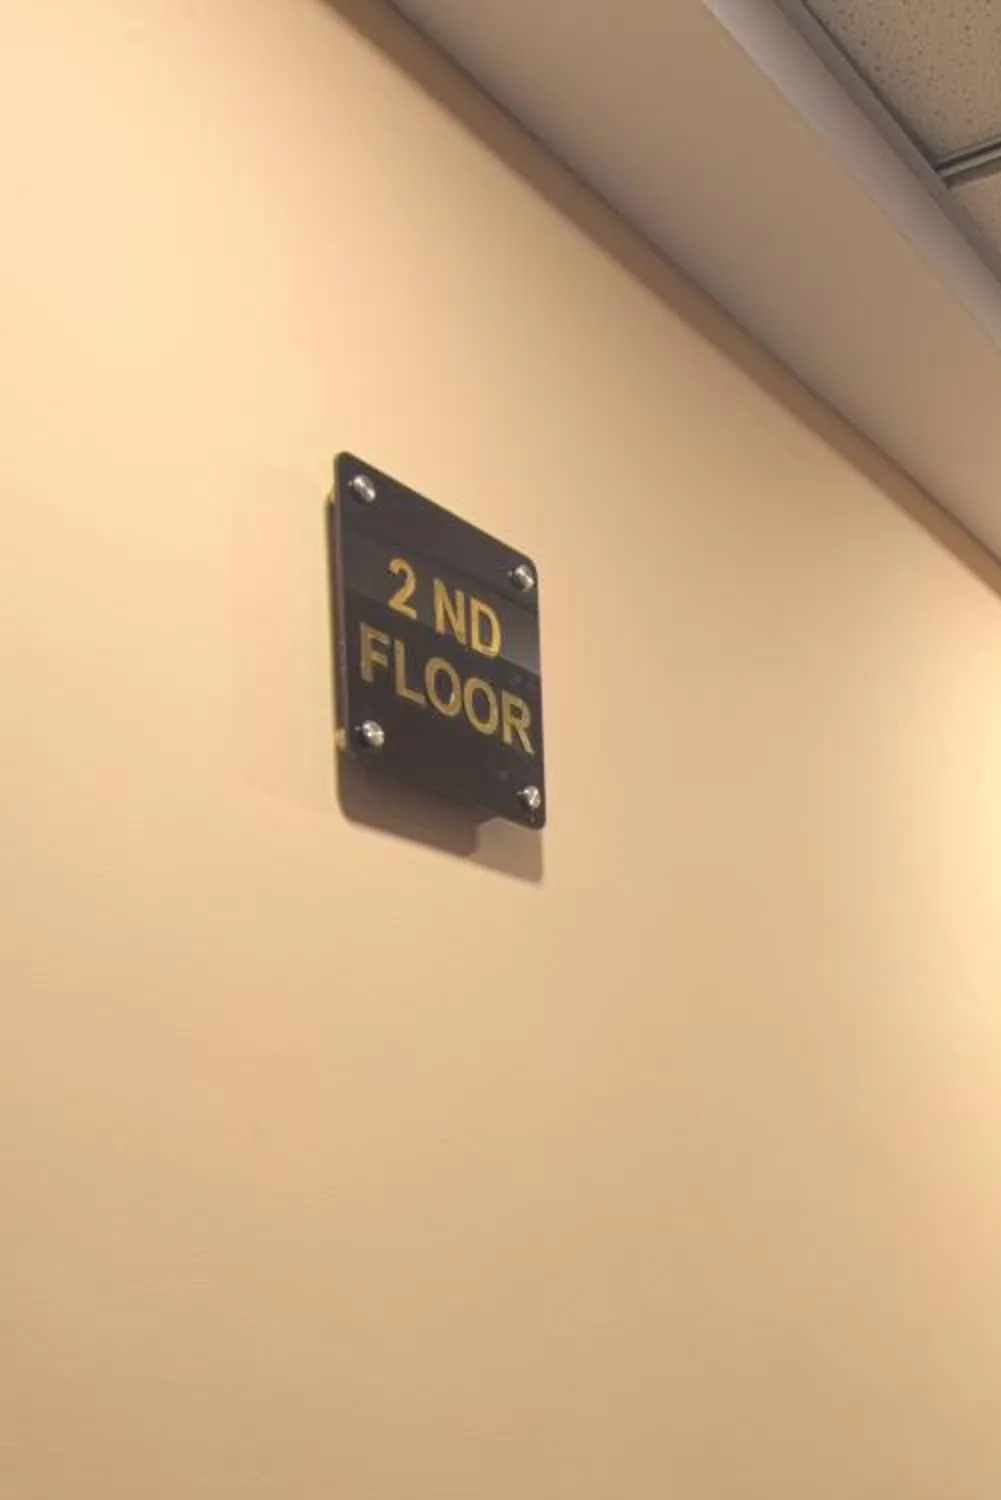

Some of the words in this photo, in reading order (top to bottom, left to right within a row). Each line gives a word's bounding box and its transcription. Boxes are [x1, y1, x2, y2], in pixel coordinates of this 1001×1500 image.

[388, 557, 417, 620] 2
[433, 577, 501, 659] ND
[359, 621, 536, 756] FLOOR
